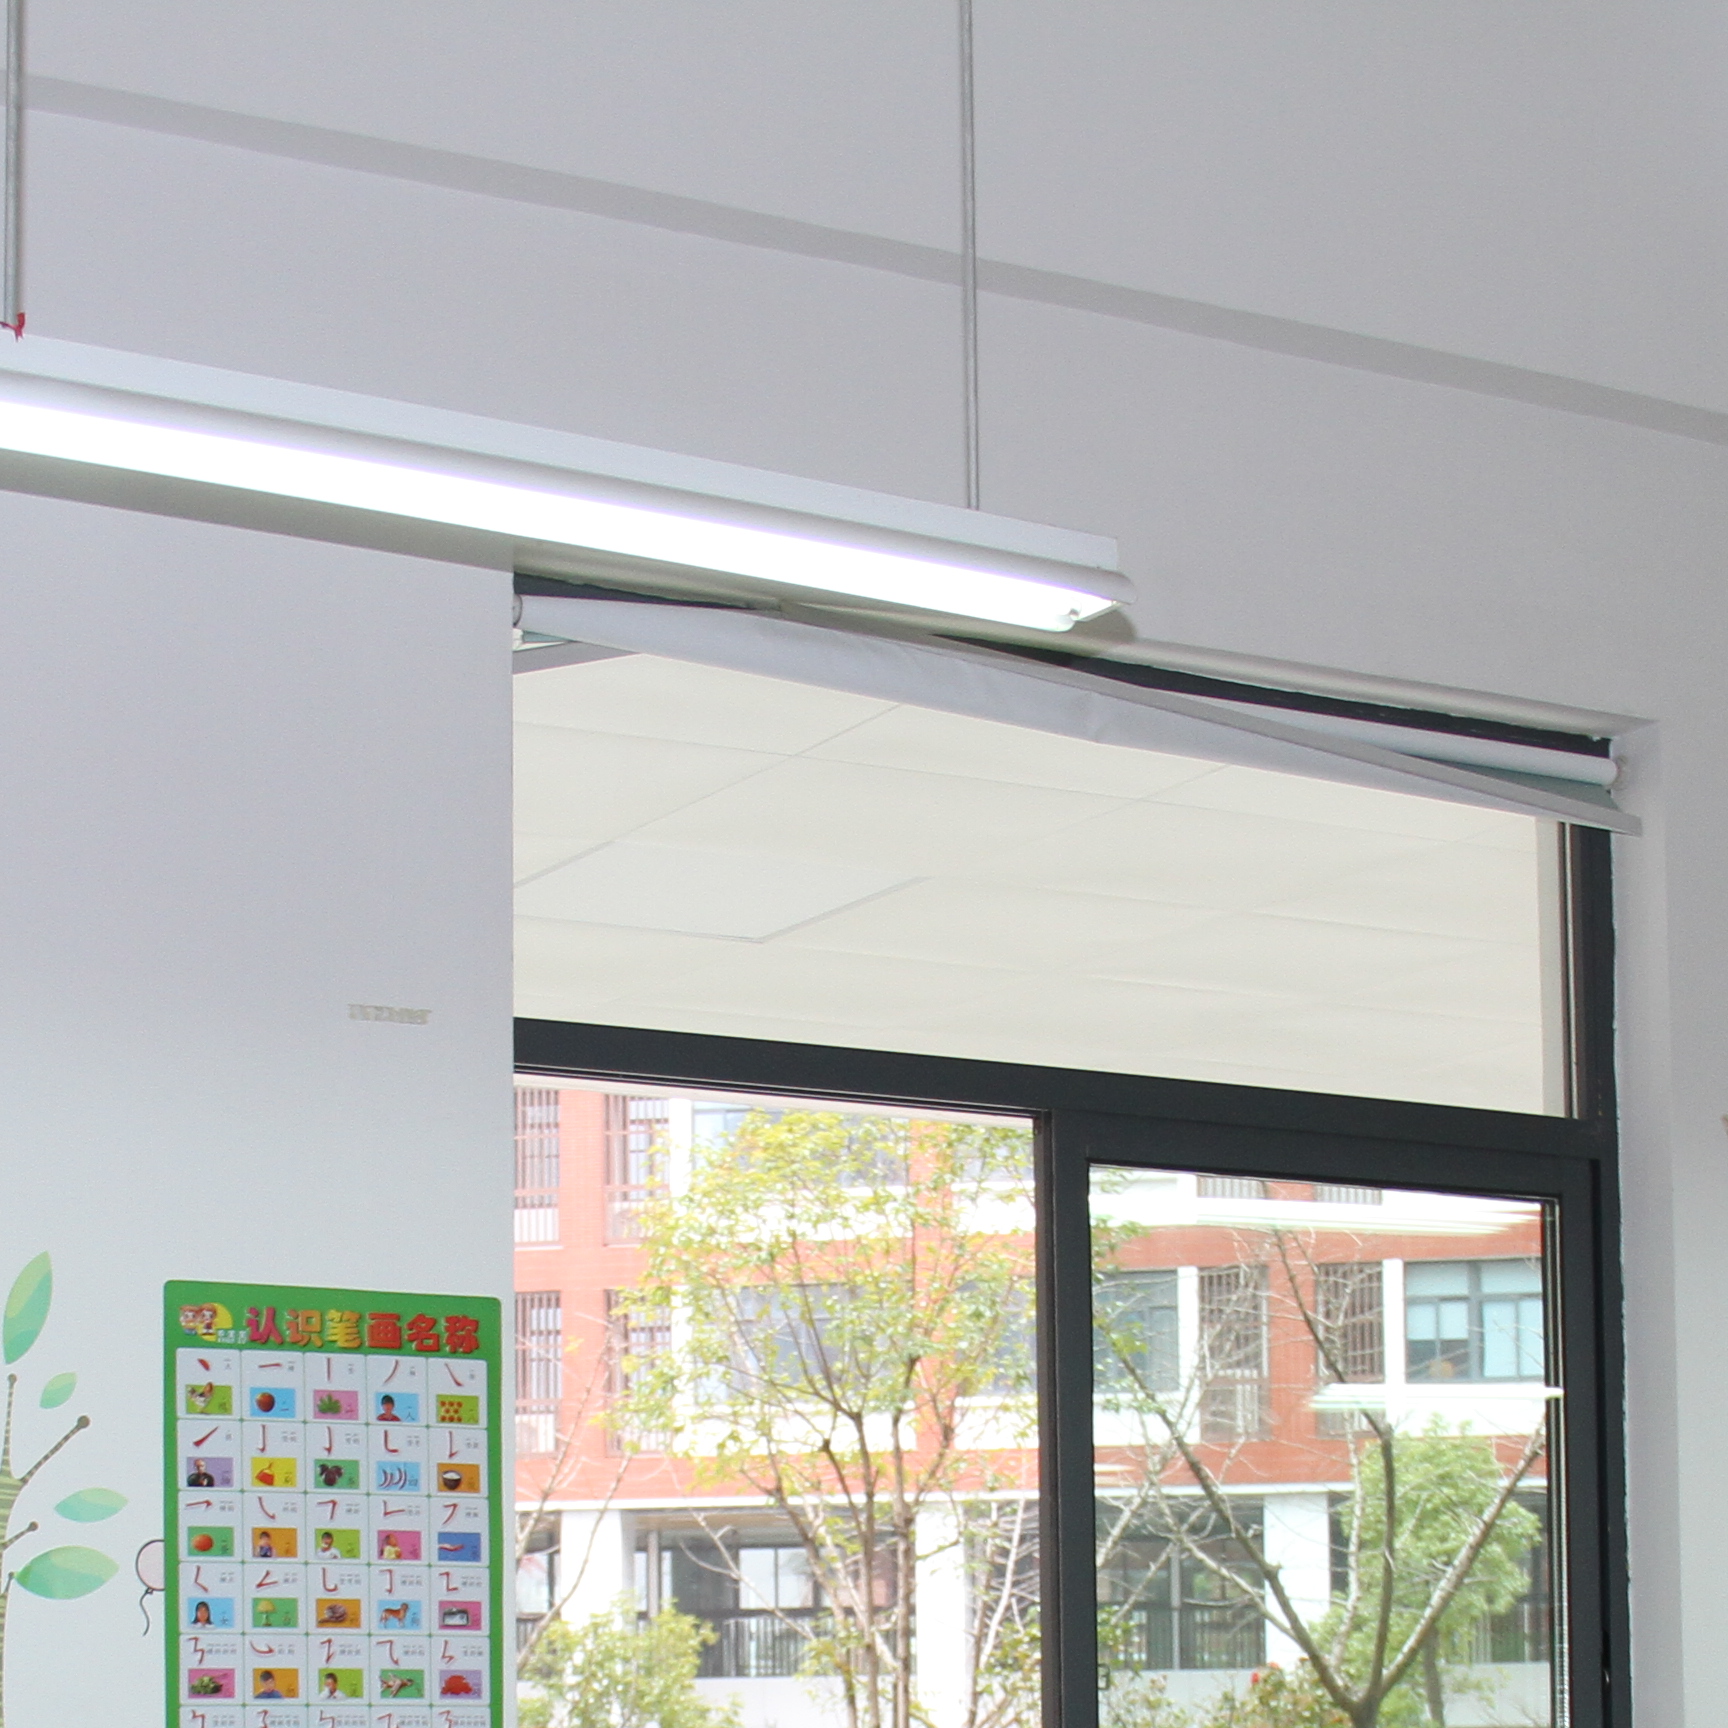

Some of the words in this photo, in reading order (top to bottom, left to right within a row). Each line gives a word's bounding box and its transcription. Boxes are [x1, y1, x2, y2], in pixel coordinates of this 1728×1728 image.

[245, 1306, 480, 1354] 认识笔画名称
